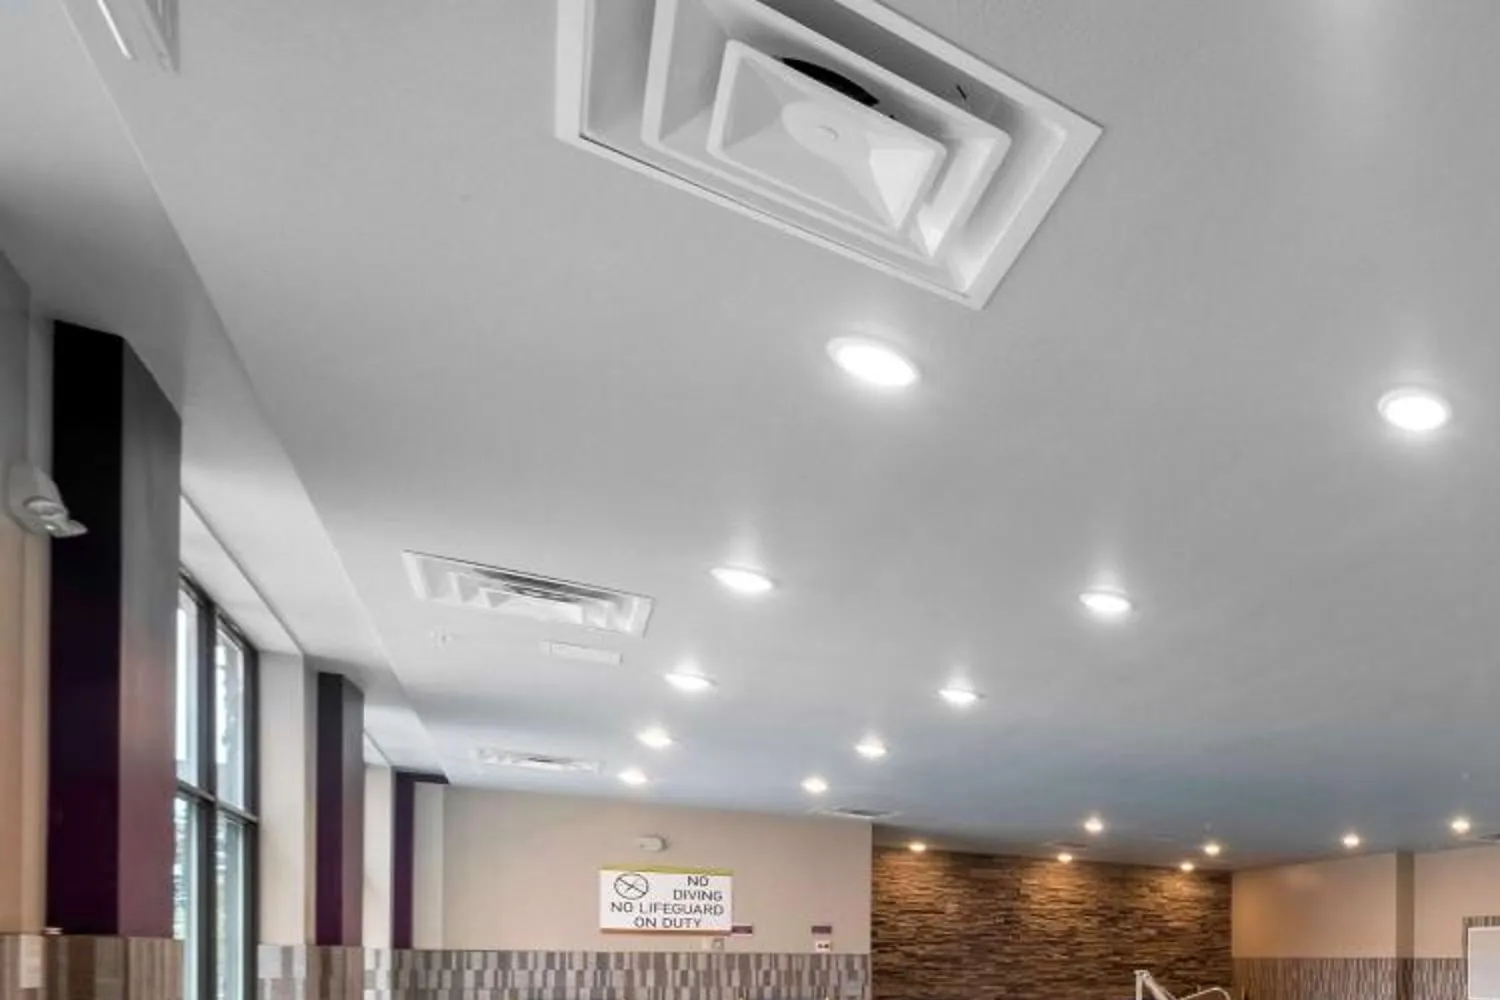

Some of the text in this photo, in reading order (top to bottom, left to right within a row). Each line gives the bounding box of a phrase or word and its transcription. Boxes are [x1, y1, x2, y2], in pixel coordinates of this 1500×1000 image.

[687, 875, 709, 887] NO
[673, 889, 723, 902] DIVING
[611, 902, 725, 916] NO LIFEGUARD
[634, 917, 703, 929] ON DUTY
